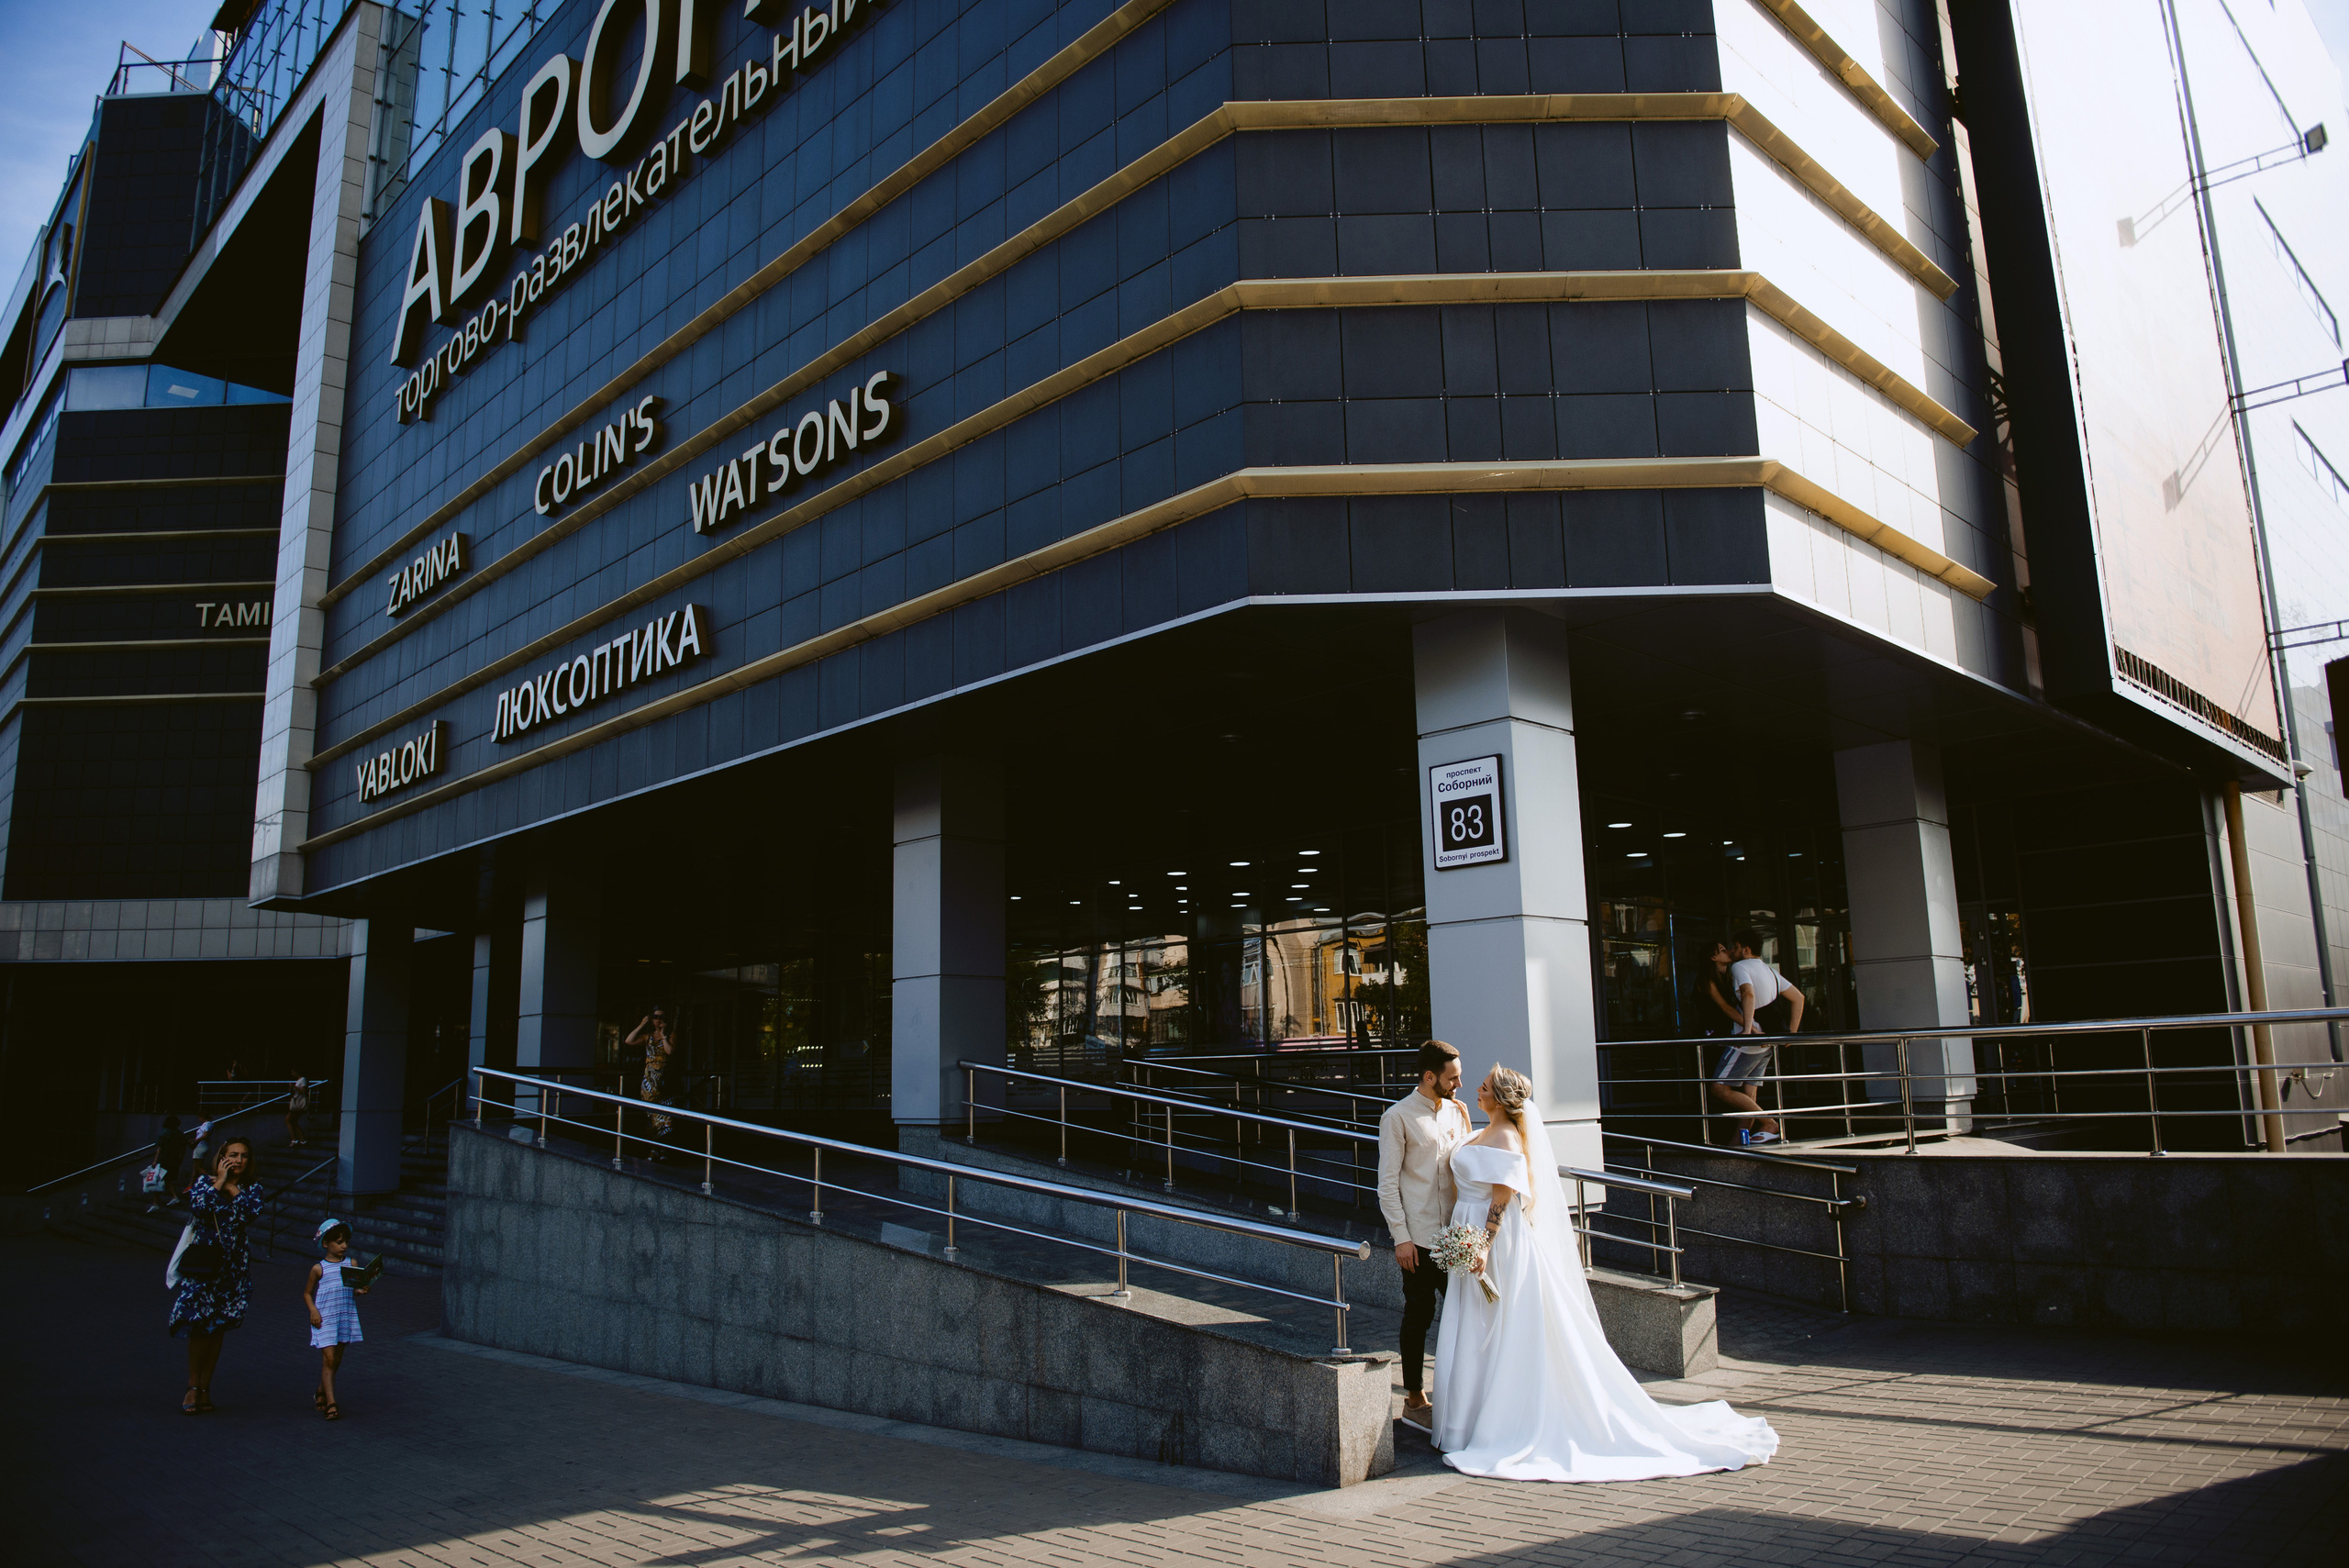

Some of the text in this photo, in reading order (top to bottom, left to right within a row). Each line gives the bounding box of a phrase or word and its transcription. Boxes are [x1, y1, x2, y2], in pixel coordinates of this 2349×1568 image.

[534, 395, 655, 516] COLIN'S
[690, 371, 891, 534] WATSONS
[387, 532, 462, 617] ZARINA
[492, 604, 701, 743] ЛЮКСОПТИКА
[1438, 774, 1492, 793] Соборний
[1446, 766, 1482, 779] проспект
[1451, 805, 1484, 841] 83
[1439, 848, 1499, 862] Sobornyi prospekt
